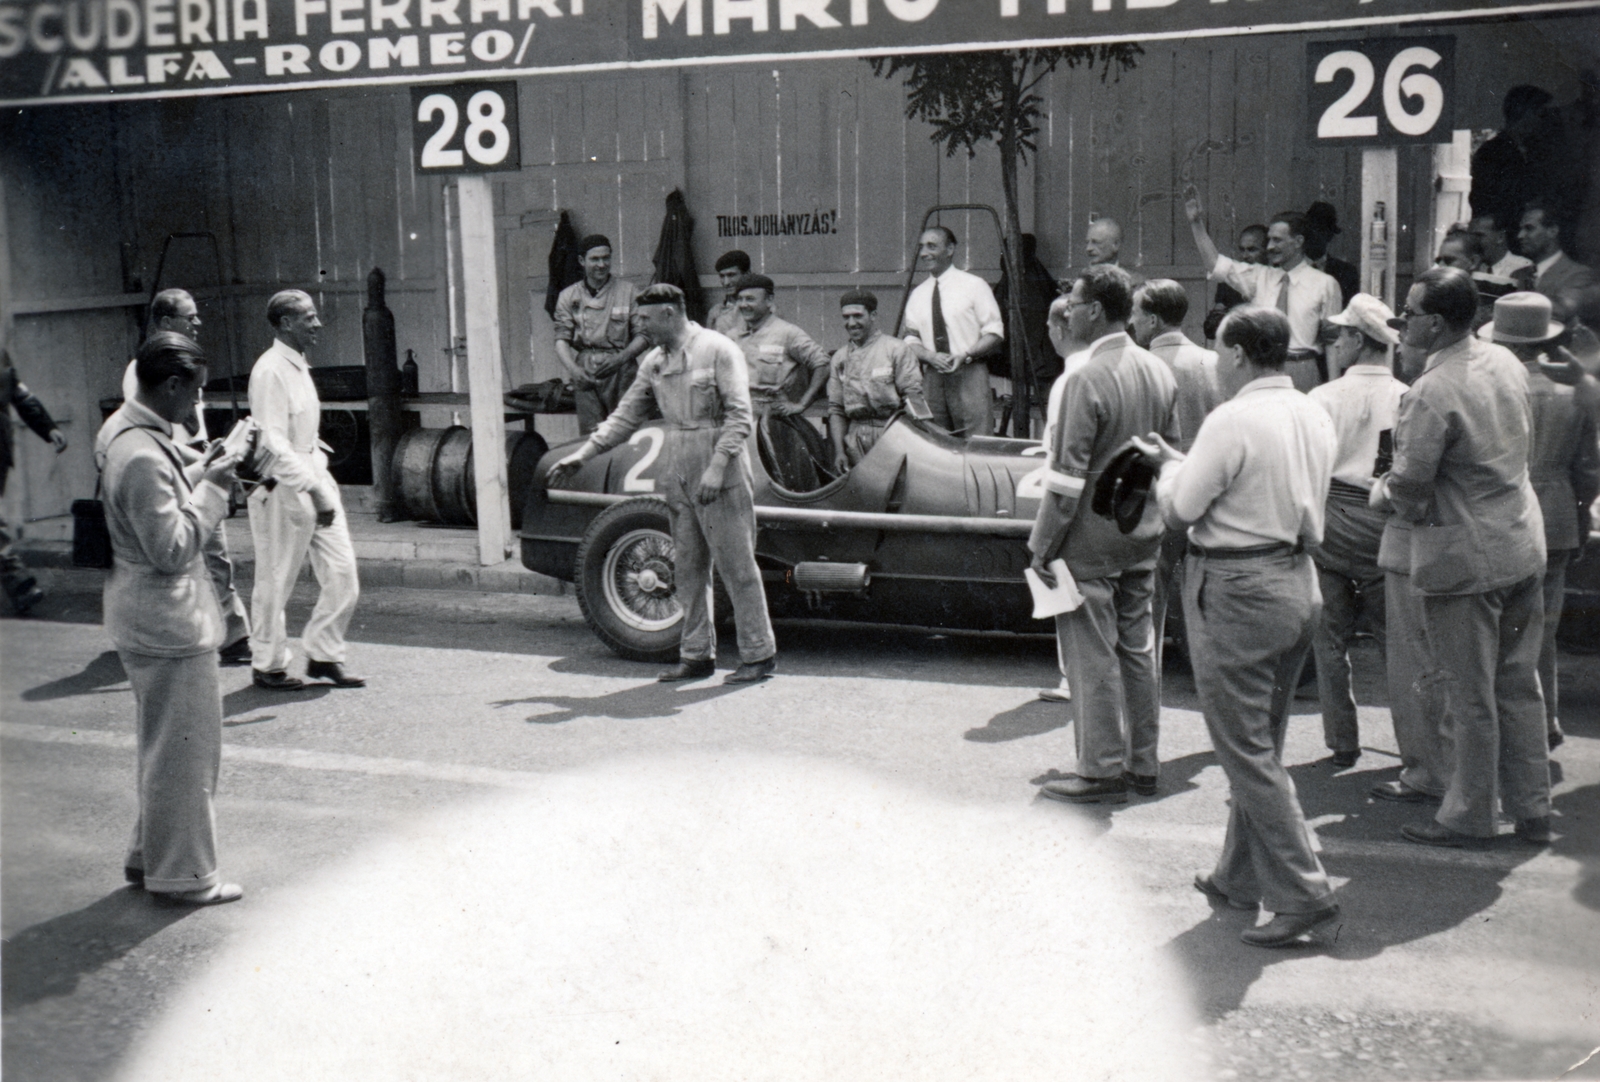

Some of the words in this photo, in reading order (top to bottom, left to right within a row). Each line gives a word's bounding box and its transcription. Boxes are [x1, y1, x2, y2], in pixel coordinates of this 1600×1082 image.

[0, 0, 269, 56] SCUDERIA
[1314, 47, 1444, 138] 26
[417, 90, 510, 168] 28
[623, 426, 665, 492] 2
